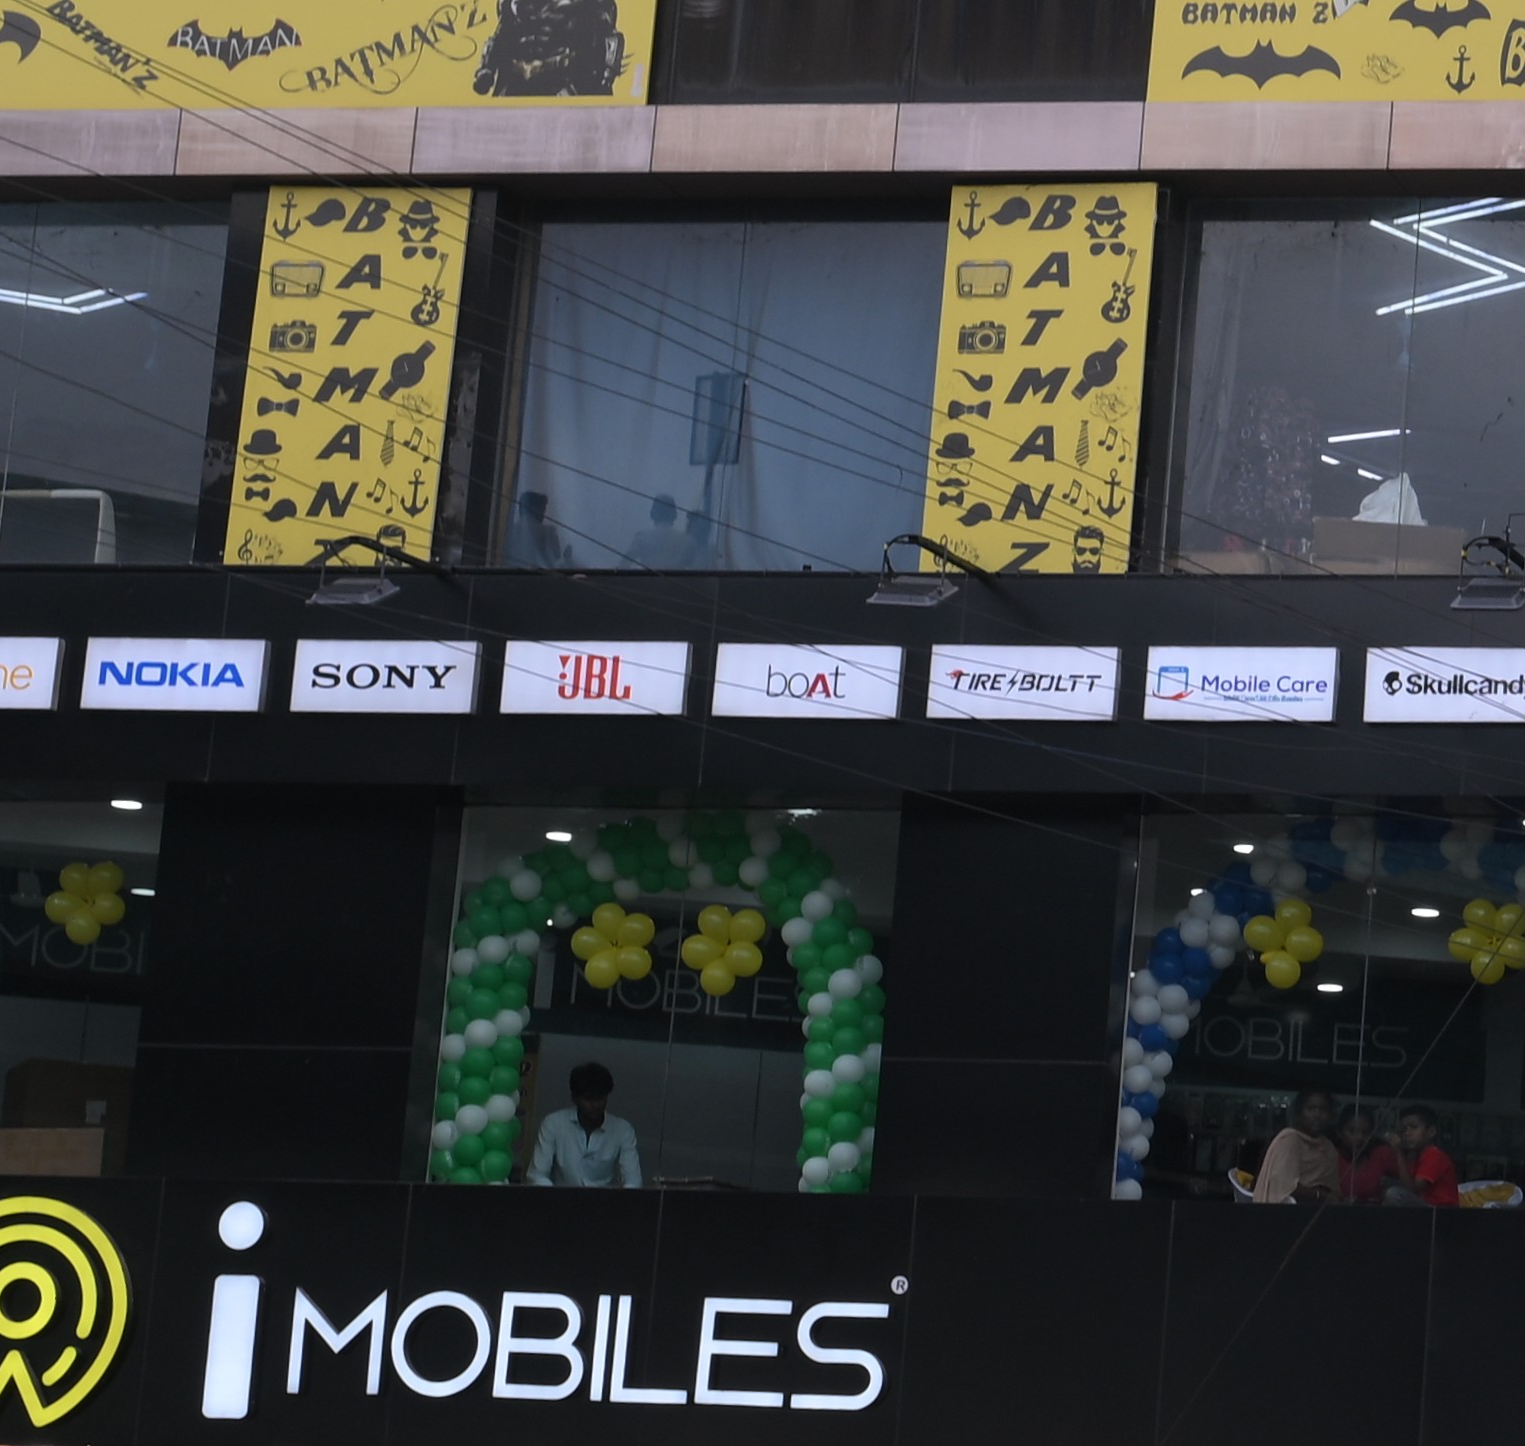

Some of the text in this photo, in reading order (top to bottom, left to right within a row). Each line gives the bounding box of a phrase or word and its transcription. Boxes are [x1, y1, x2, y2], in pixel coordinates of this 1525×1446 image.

[175, 26, 301, 59] BATMAN
[99, 661, 244, 687] NOKIA
[311, 664, 457, 689] SONY
[559, 655, 631, 699] JBL
[1200, 675, 1328, 693] Mobile Care
[570, 968, 803, 1022] MOBILE
[201, 1202, 264, 1420] i
[286, 1287, 890, 1412] MOBILES
